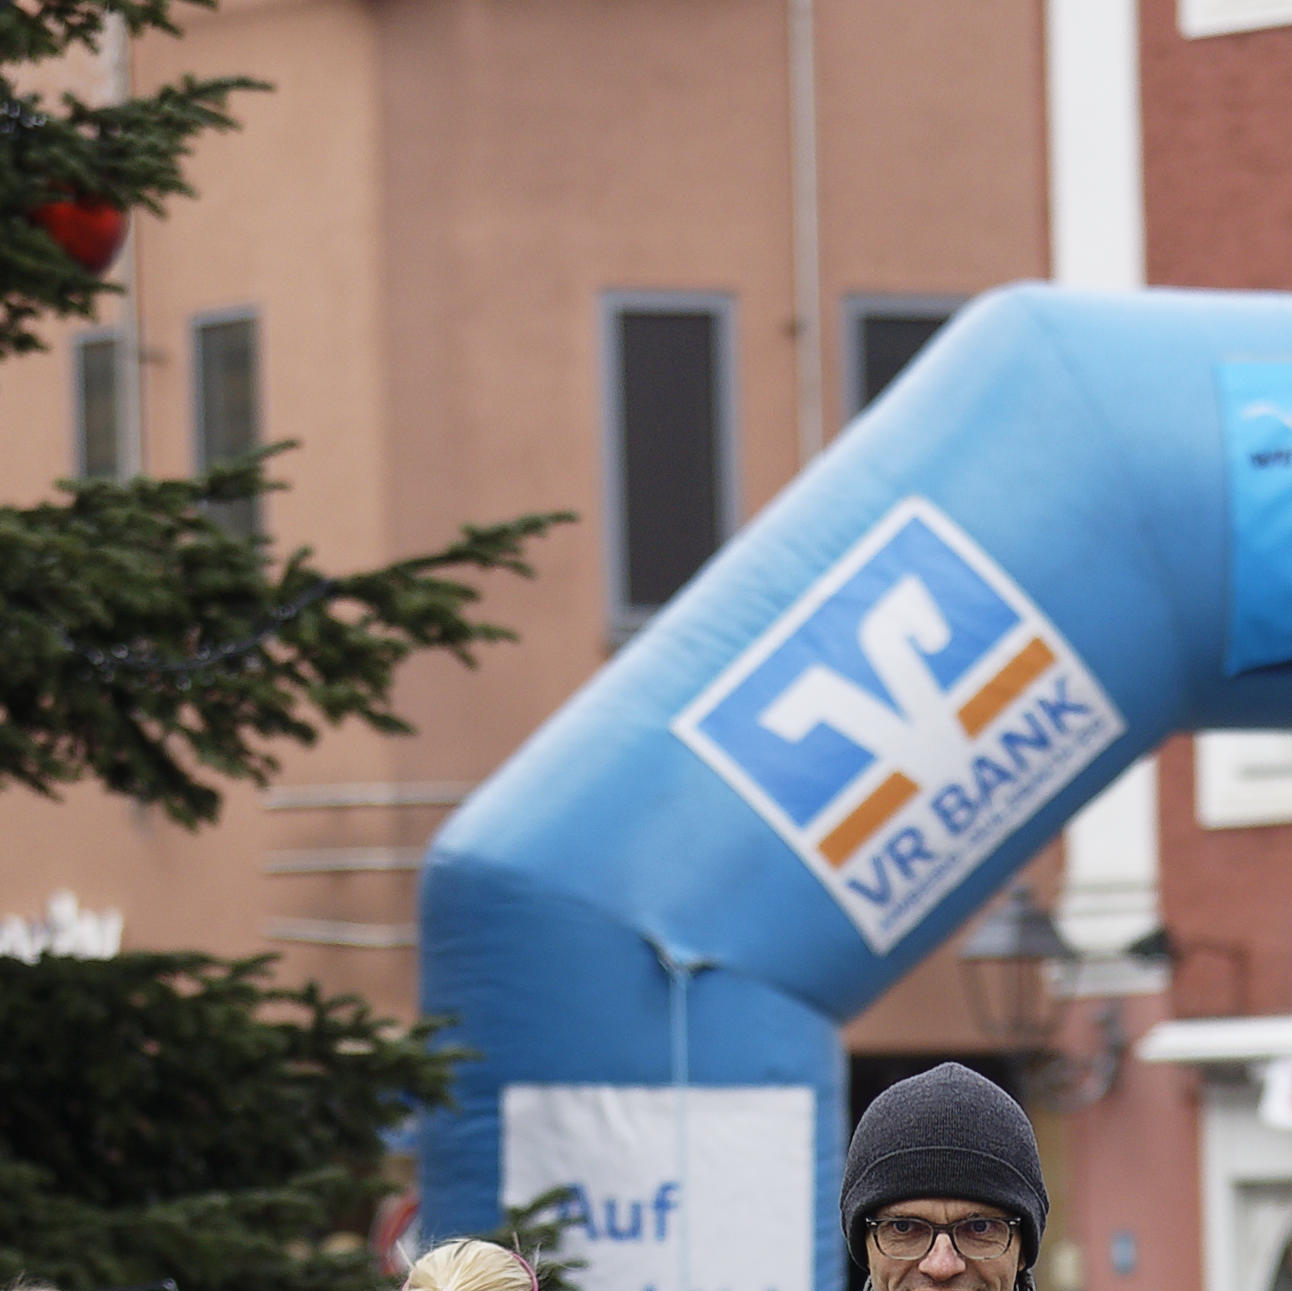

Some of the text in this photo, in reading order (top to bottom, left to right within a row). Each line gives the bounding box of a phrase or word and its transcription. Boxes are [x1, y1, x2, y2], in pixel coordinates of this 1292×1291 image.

[846, 825, 935, 907] VR
[930, 677, 1092, 834] BANK
[559, 1182, 683, 1242] Auf
